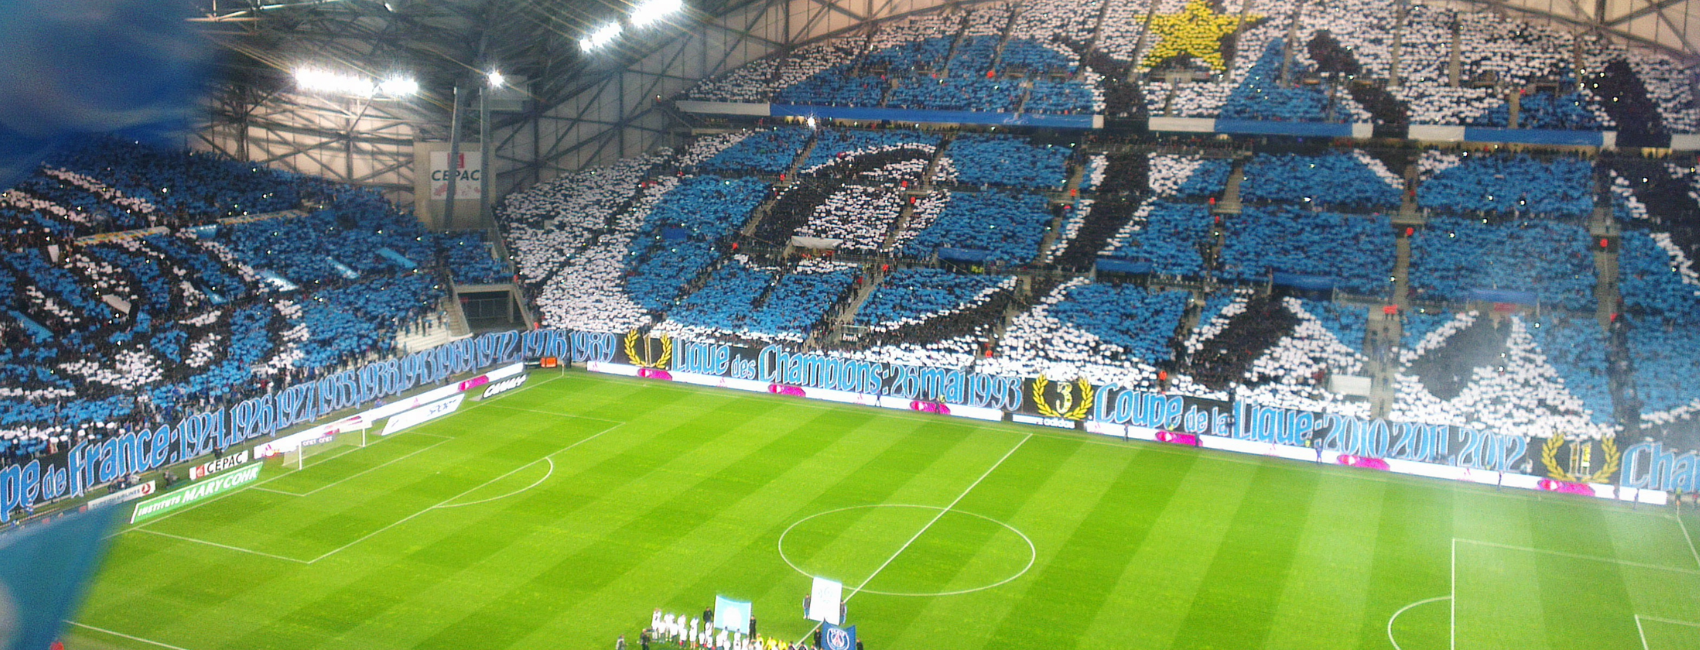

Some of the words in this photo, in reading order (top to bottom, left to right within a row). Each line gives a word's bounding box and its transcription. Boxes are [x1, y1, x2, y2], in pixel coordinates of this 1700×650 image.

[431, 169, 480, 181] CEPAC
[731, 354, 757, 380] des
[891, 364, 920, 399] 26
[920, 366, 966, 404] mai
[967, 372, 1023, 412] 1993
[1055, 381, 1073, 414] 3
[43, 464, 66, 500] de
[569, 330, 617, 363] 1989
[1094, 382, 1184, 430] Coupe
[1184, 405, 1208, 433] de
[1211, 407, 1229, 436] la
[1457, 426, 1528, 473] 2012
[206, 452, 243, 473] CEPAC
[1569, 441, 1592, 478] 11
[1620, 440, 1700, 493] Cha
[138, 495, 181, 516] INSTITUTS
